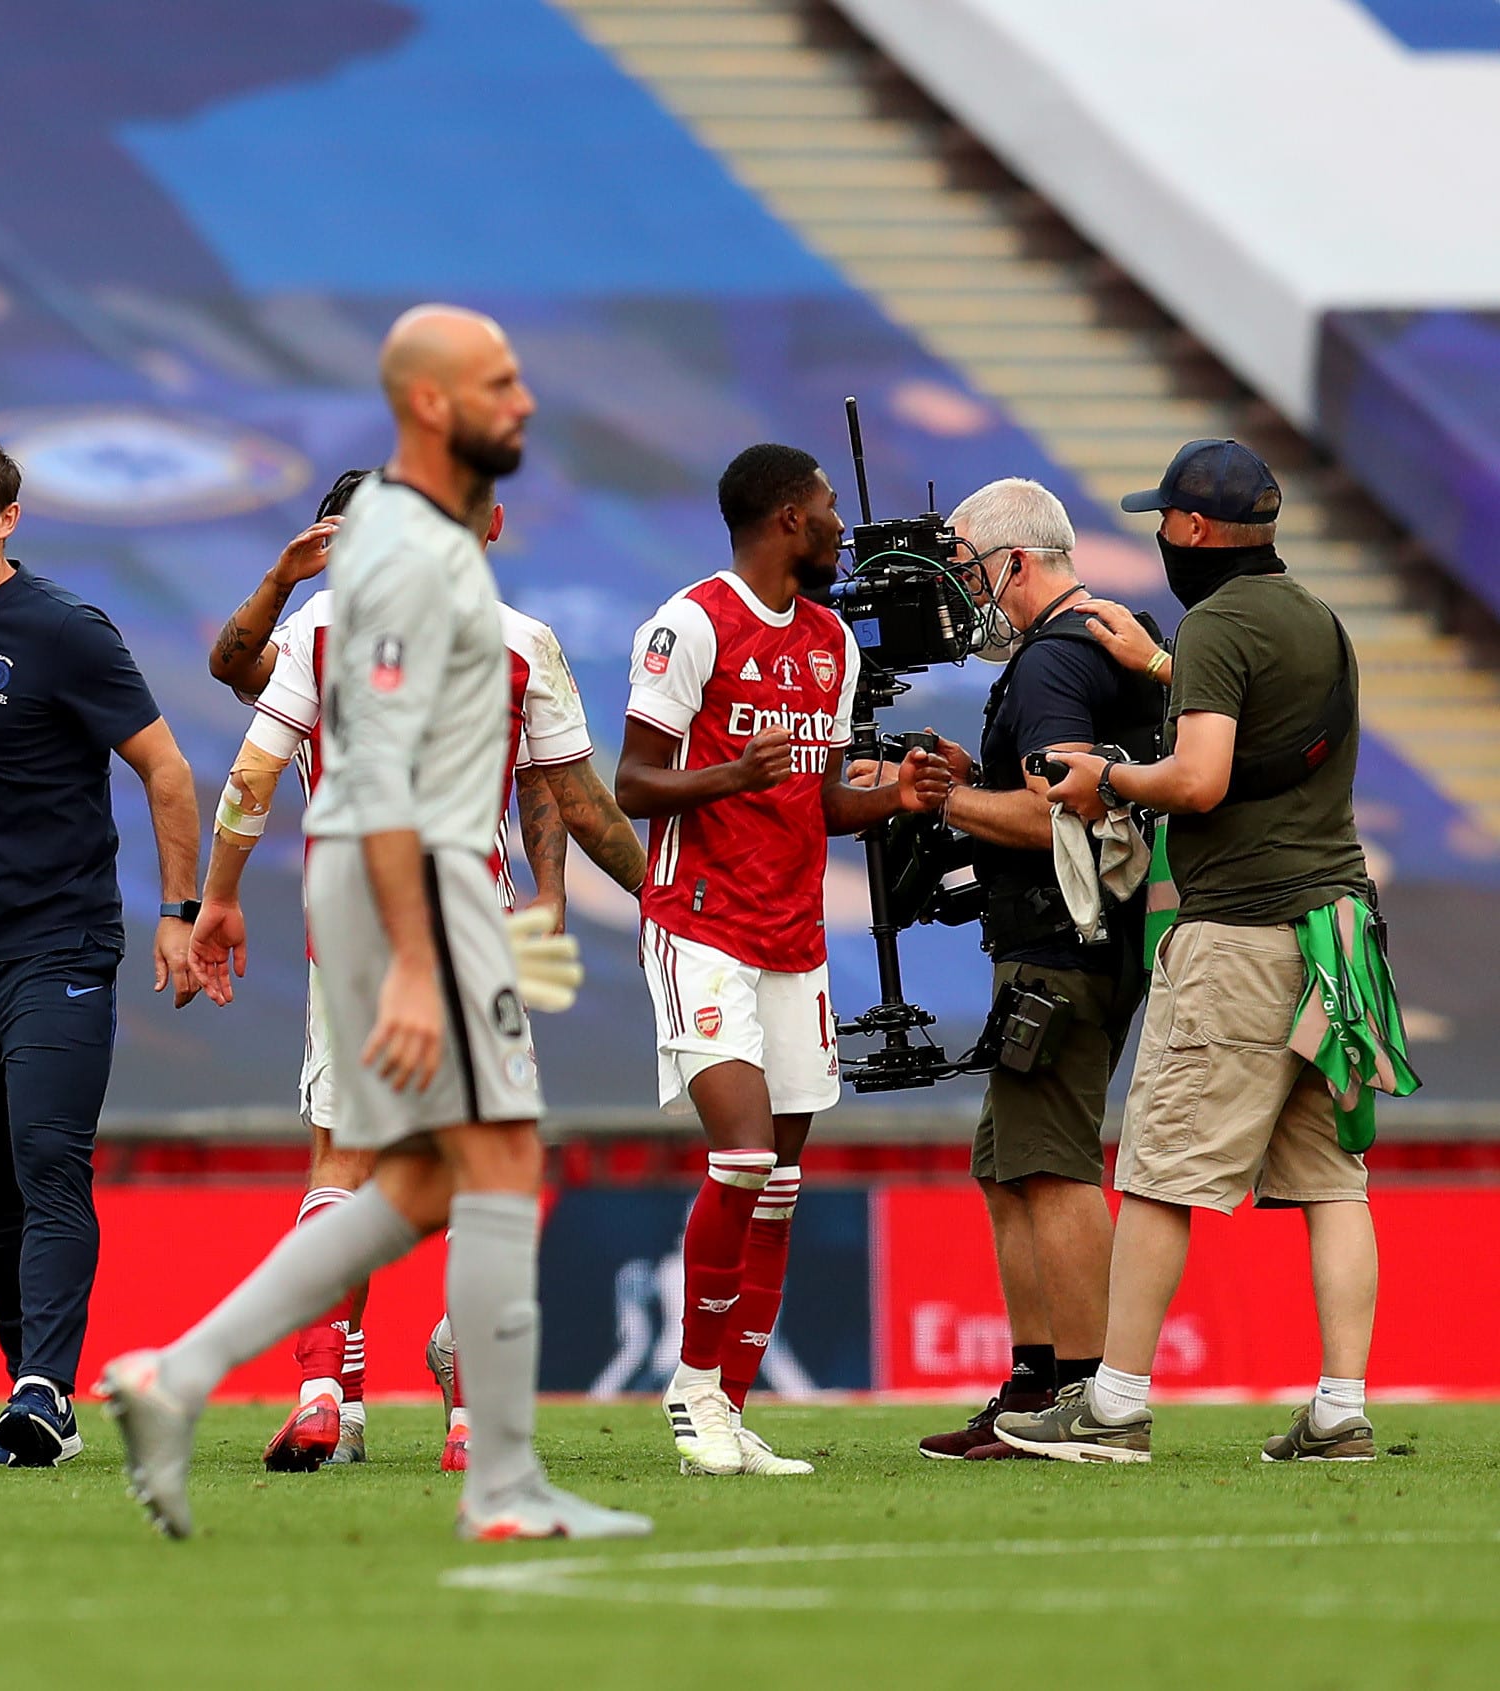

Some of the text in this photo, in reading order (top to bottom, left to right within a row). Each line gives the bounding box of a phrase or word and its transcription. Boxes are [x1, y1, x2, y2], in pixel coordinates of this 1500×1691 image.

[848, 603, 873, 612] SONY
[861, 622, 874, 642] 5
[728, 702, 834, 741] Emirate
